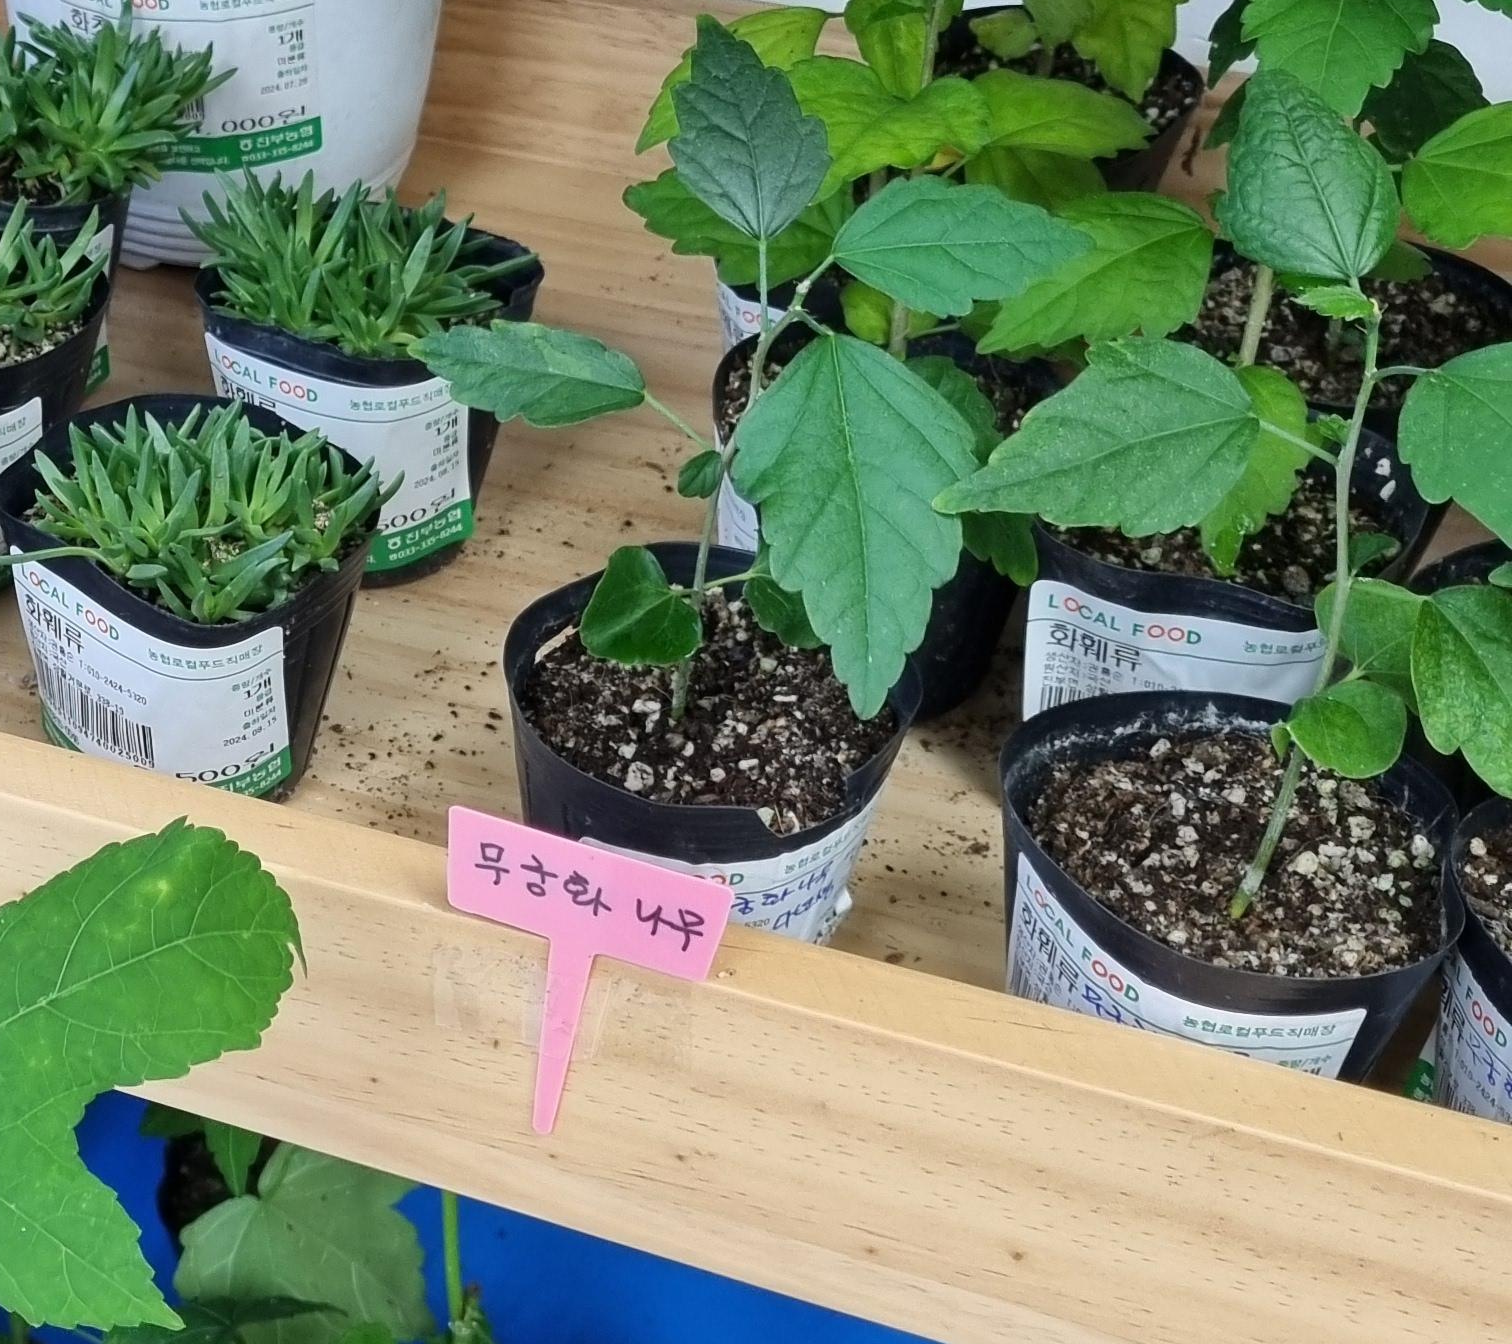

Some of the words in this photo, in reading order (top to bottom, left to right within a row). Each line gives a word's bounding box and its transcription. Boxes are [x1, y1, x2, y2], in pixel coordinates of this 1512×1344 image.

[279, 29, 304, 46] 1개
[215, 348, 262, 385] LOCAL
[269, 376, 318, 403] FOOD
[21, 564, 69, 609] LOCAL
[76, 602, 120, 641] FOOD
[25, 594, 85, 654] 화훼류
[1048, 593, 1122, 633] LOCAL
[1132, 622, 1202, 645] FOOD
[1045, 622, 1143, 673] 화훼류
[244, 676, 272, 700] 1개
[474, 839, 612, 917] 무궁화
[635, 897, 705, 953] 나무
[1021, 901, 1080, 994] 화훼류
[1026, 874, 1075, 948] LOCAL
[1091, 945, 1140, 1003] FOOD
[1182, 1016, 1337, 1039] 농협로컬푸드직매장
[1465, 984, 1508, 1048] FOOD
